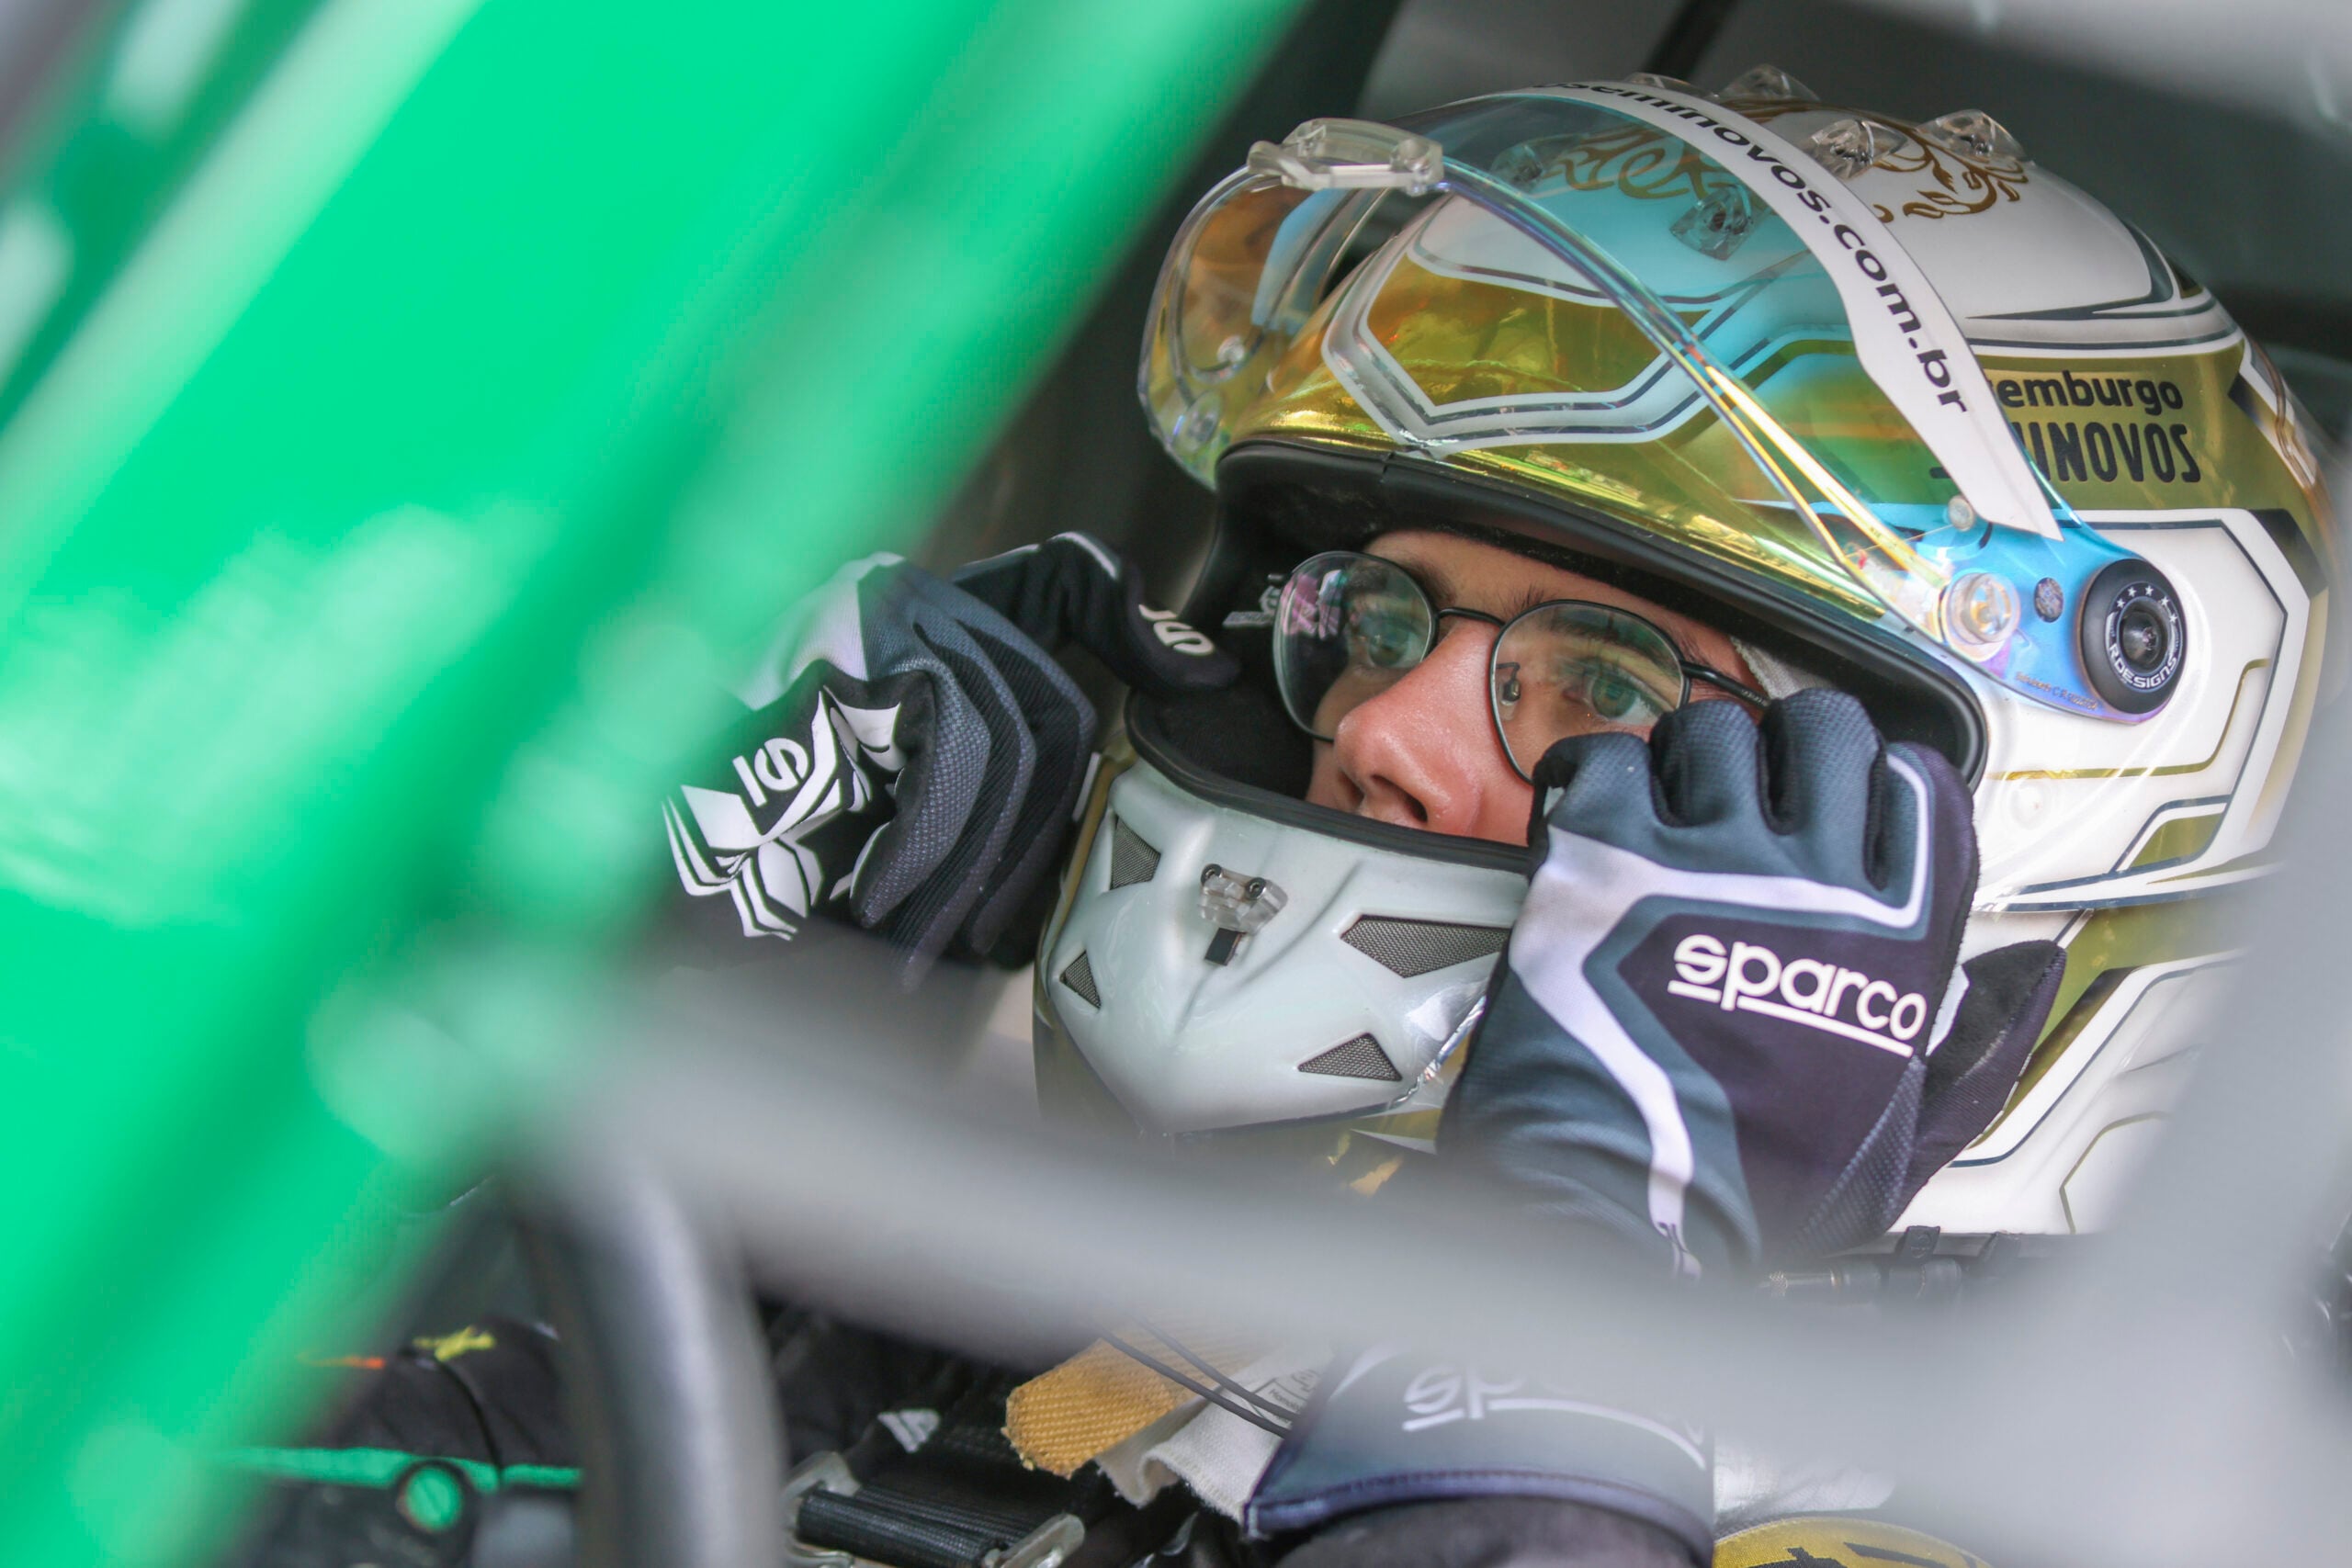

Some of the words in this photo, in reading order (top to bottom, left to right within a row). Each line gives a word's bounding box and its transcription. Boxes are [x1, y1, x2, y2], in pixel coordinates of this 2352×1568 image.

[1989, 369, 2184, 416] emburgo
[2011, 421, 2201, 483] INOVOS
[1673, 933, 1928, 1042] sparco
